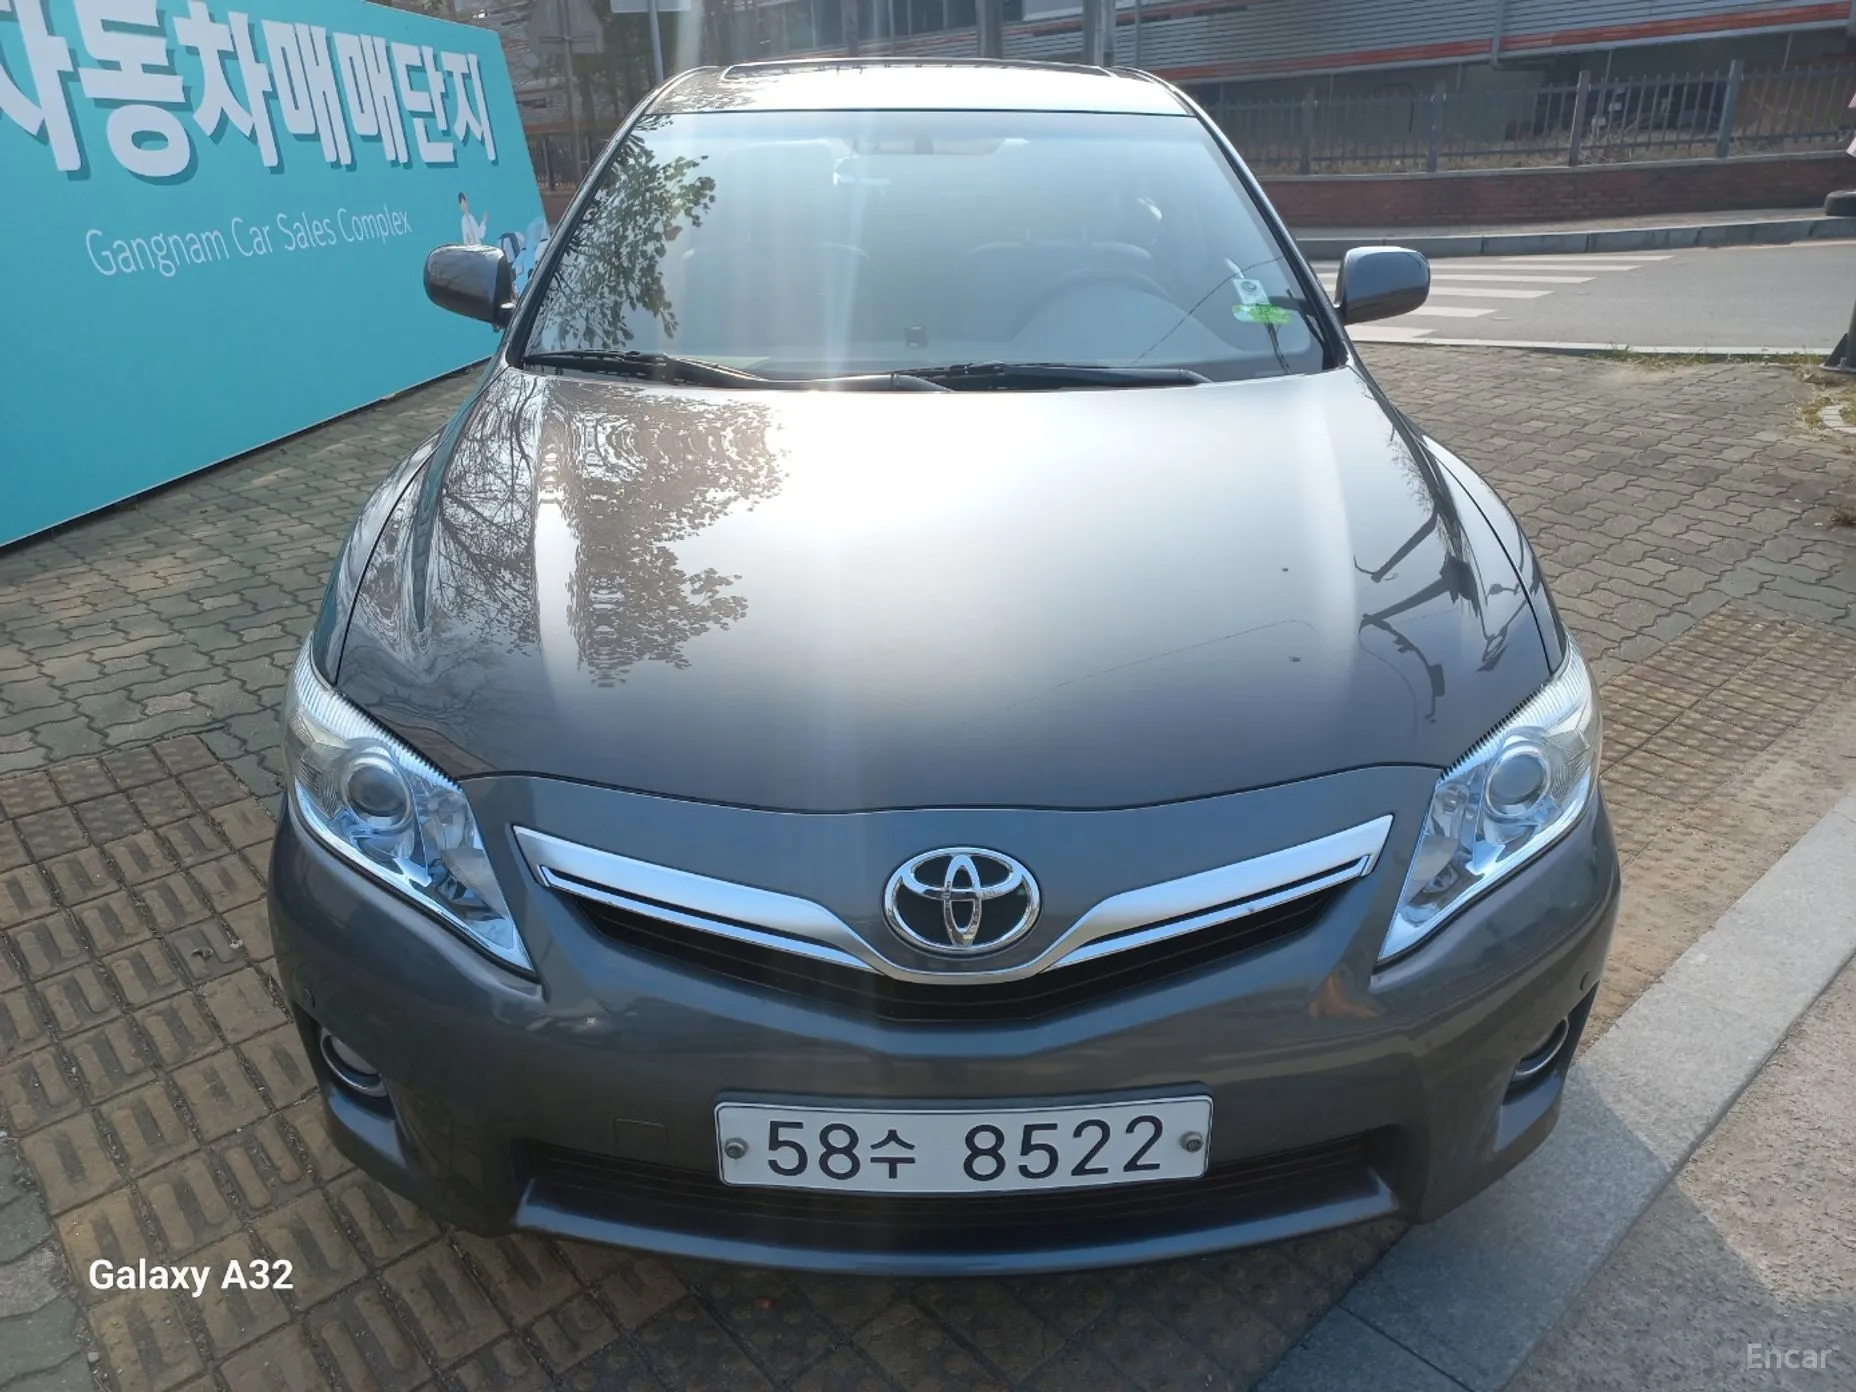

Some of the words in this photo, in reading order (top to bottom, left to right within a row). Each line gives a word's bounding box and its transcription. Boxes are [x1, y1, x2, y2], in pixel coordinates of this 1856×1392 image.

[86, 228, 230, 278] Gangnam
[231, 216, 273, 257] Car
[276, 211, 337, 251] Sales
[337, 203, 413, 244] Complex
[767, 1120, 916, 1181] 58수
[963, 1115, 1164, 1182] 8522
